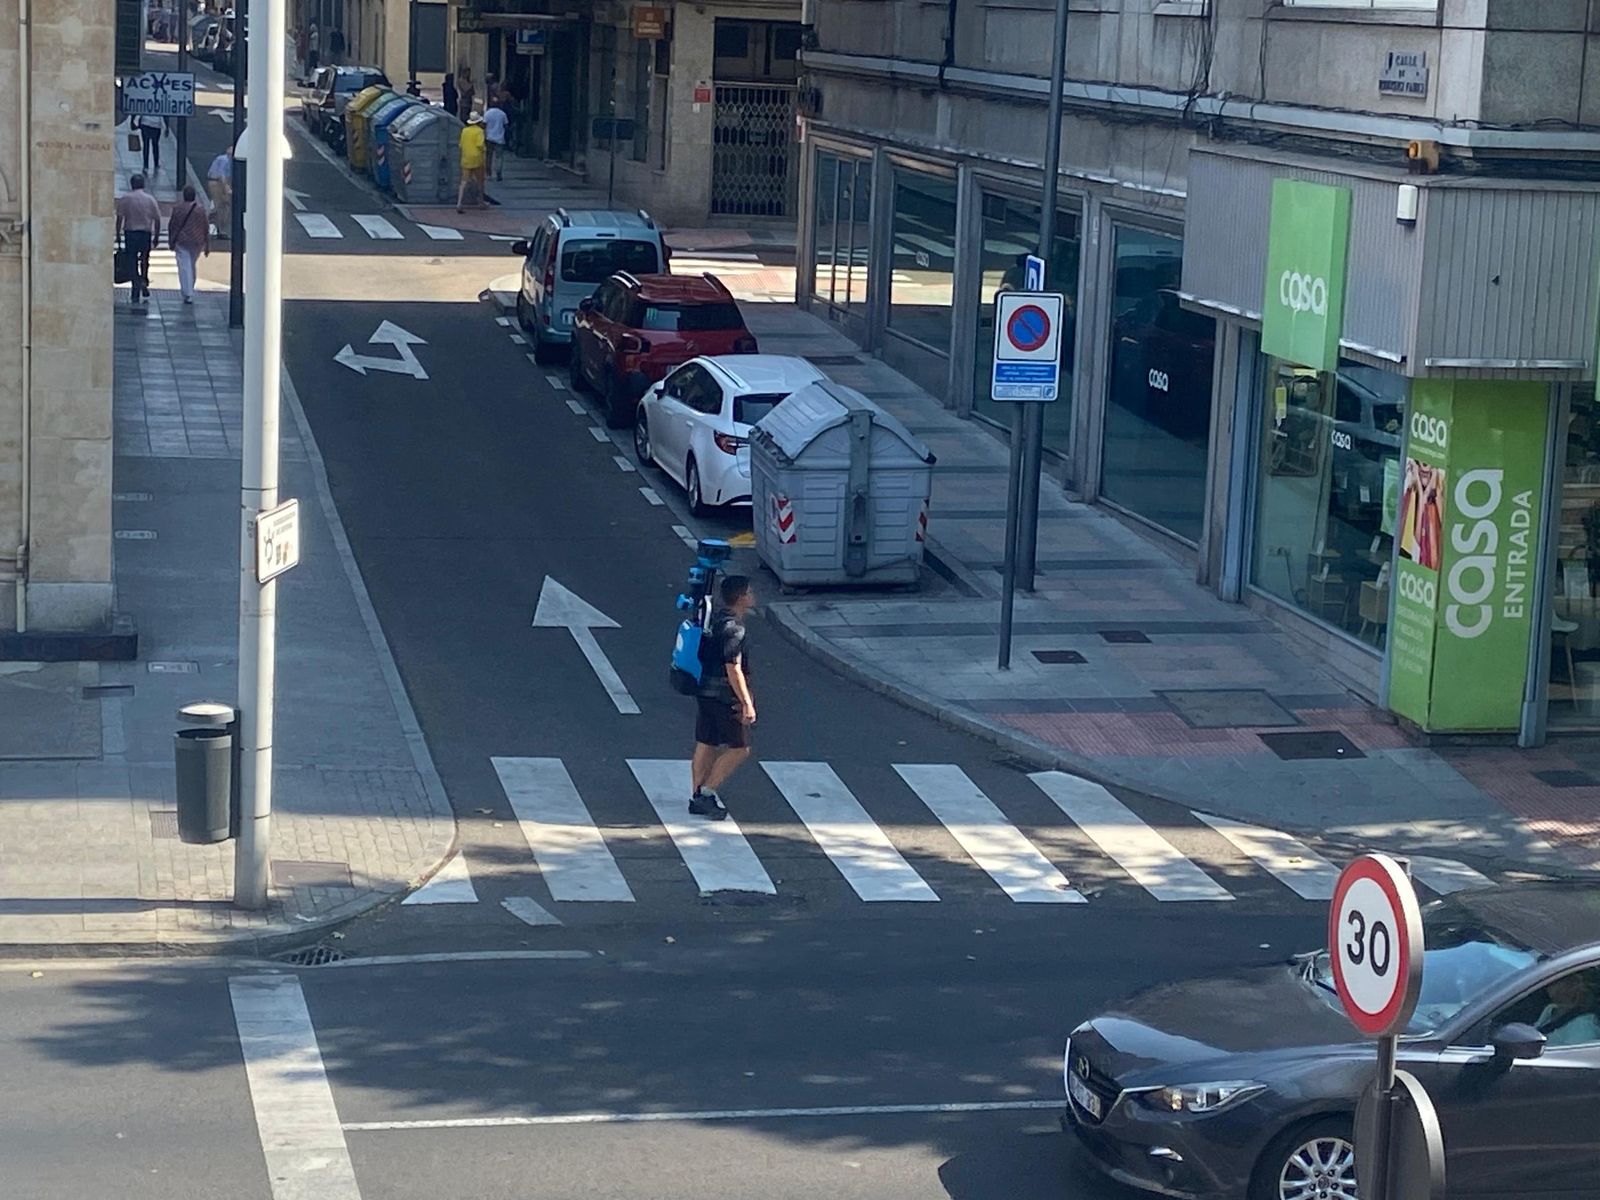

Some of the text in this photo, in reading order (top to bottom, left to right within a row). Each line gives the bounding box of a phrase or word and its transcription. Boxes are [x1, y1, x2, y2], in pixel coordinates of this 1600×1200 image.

[124, 94, 193, 114] Inmobiliaria
[1280, 269, 1325, 316] casa
[1149, 368, 1169, 392] casa
[1331, 429, 1351, 450] casa
[1411, 411, 1447, 448] casa
[1445, 468, 1505, 639] casa
[1503, 490, 1533, 618] ENTRADA
[1399, 571, 1435, 609] casa
[1347, 909, 1390, 977] 30
